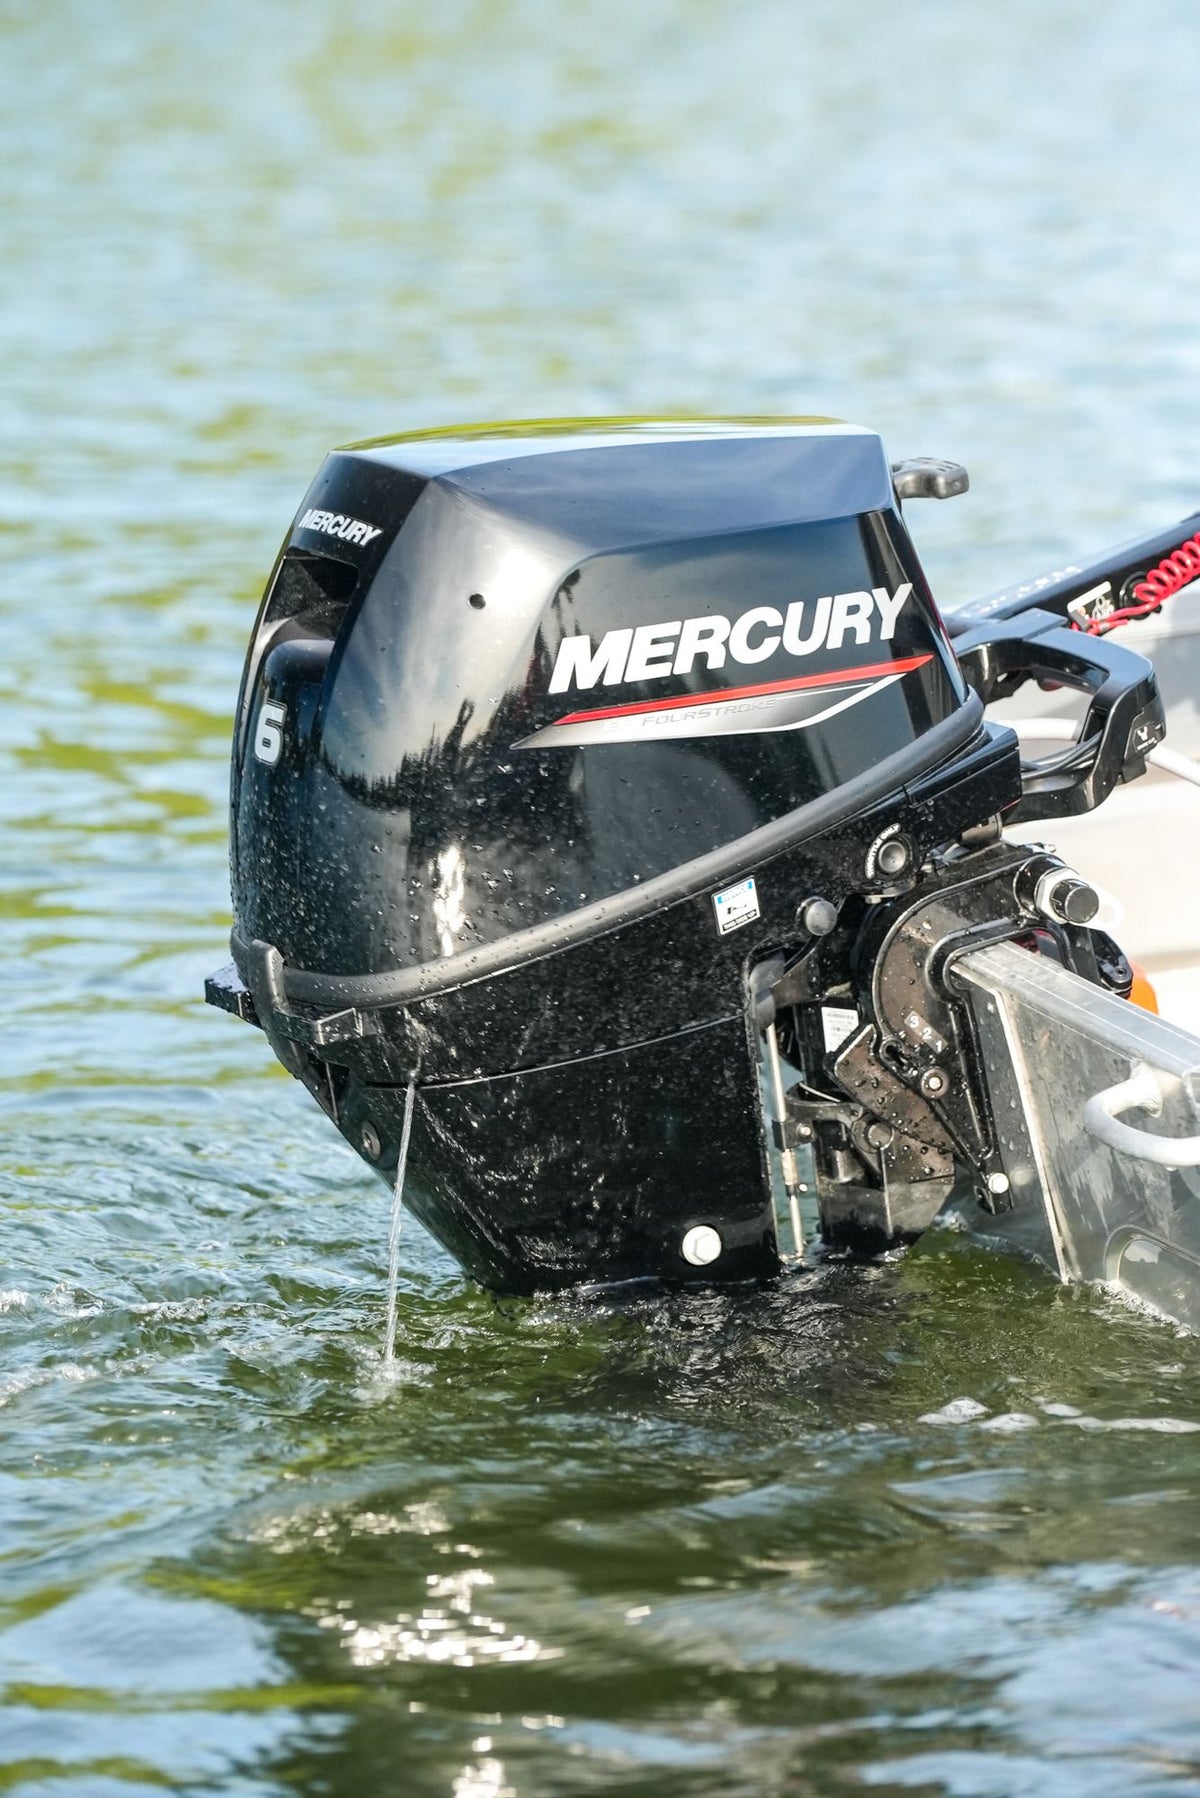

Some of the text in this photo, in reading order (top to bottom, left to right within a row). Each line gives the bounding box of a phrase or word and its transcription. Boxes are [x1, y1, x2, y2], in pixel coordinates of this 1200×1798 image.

[298, 508, 383, 547] MERCURY
[548, 582, 914, 696] MERCURY
[641, 699, 777, 727] FOURSTROKE
[254, 703, 285, 764] 6
[909, 1015, 942, 1052] 3 2 1
